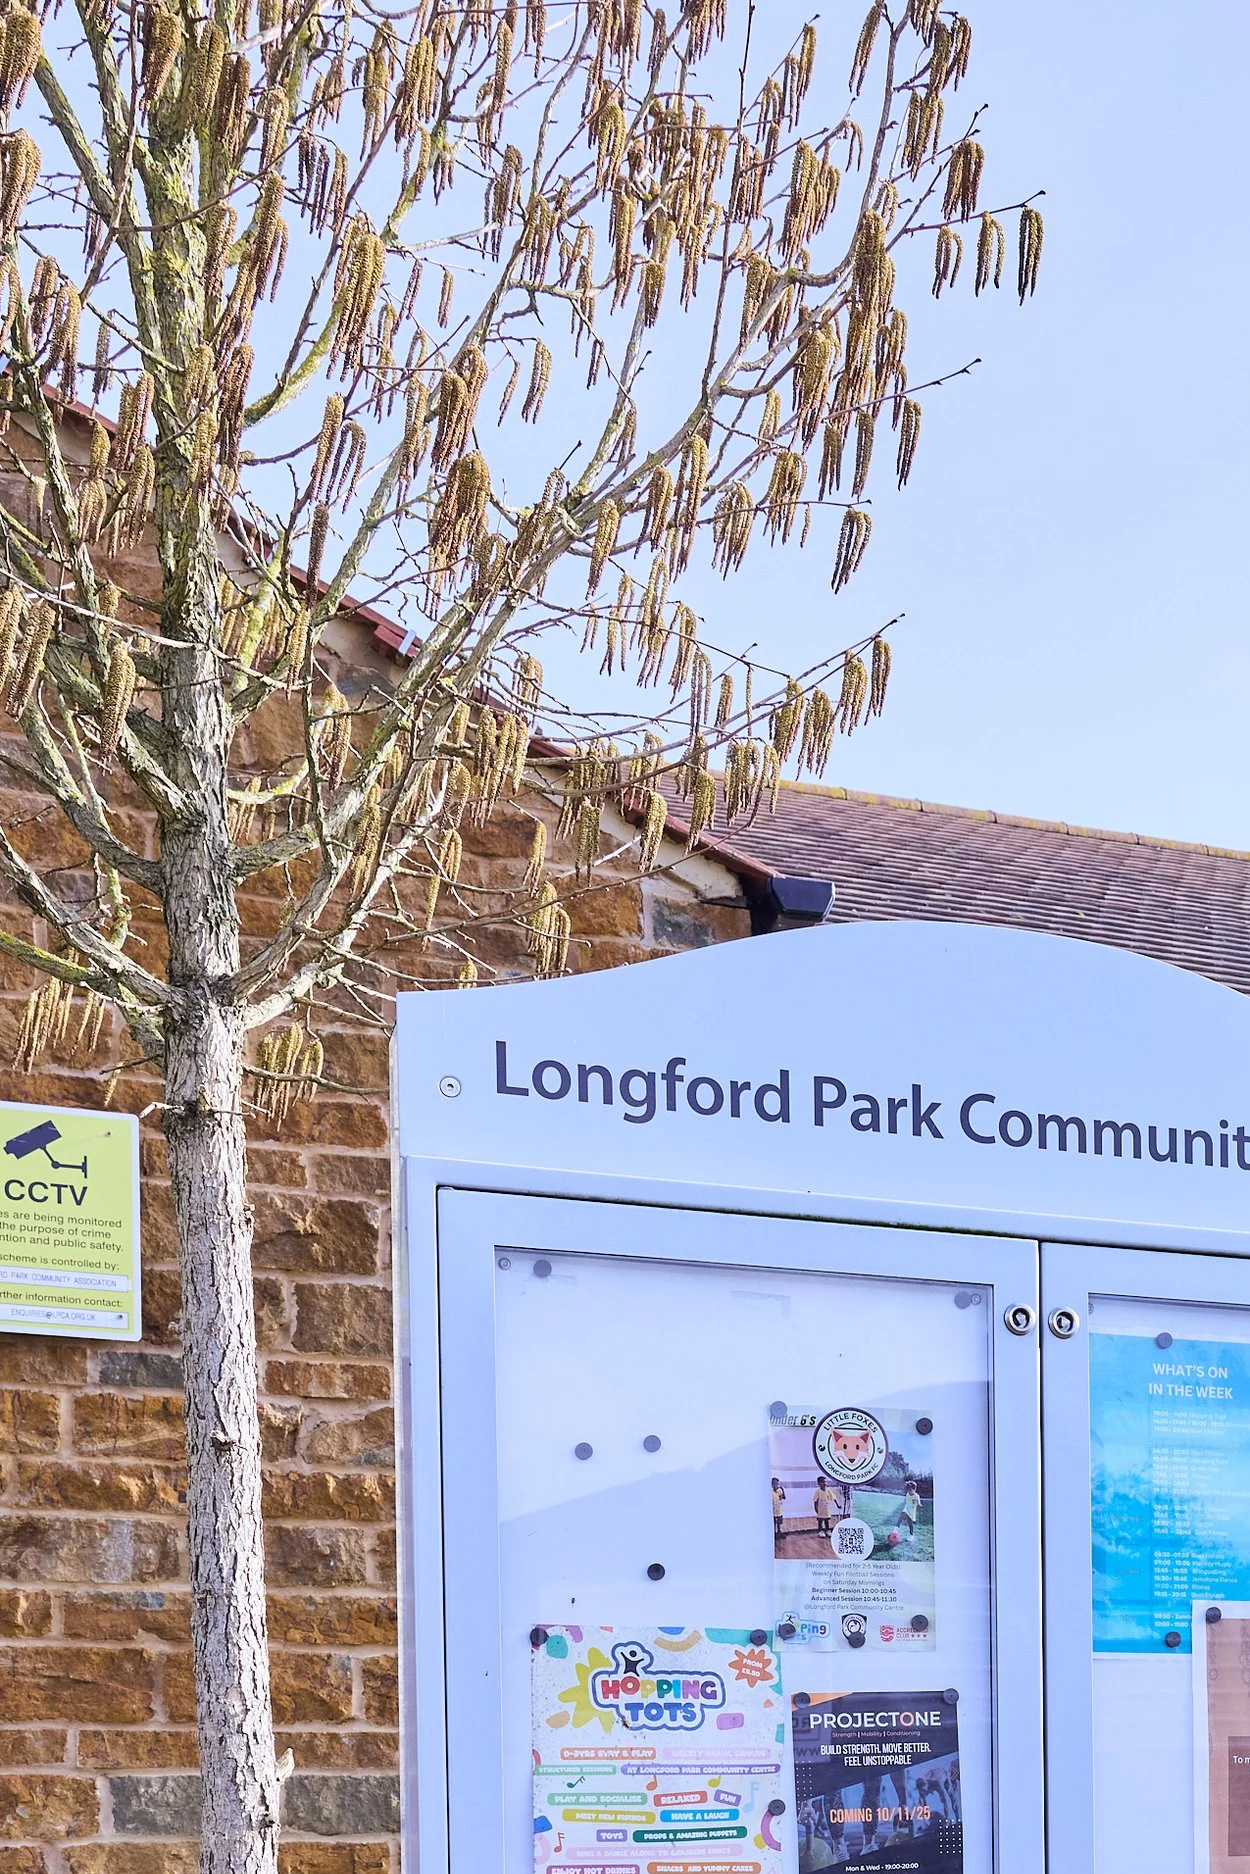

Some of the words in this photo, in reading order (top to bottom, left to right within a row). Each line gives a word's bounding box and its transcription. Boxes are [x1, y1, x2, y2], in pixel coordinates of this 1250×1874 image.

[494, 1040, 790, 1124] Longford
[813, 1076, 943, 1138] Park
[4, 1179, 88, 1206] CCTV
[13, 1212, 30, 1220] are
[33, 1212, 64, 1225] being
[67, 1216, 122, 1228] monitored
[20, 1224, 65, 1235] purpose
[68, 1228, 78, 1236] of
[81, 1229, 111, 1239] crime
[29, 1236, 50, 1245] and
[53, 1238, 87, 1249] public
[89, 1241, 124, 1253] safety.
[40, 1256, 48, 1264] is
[51, 1257, 101, 1269] controlled
[104, 1261, 120, 1272] by:
[11, 1270, 29, 1280] PARK
[32, 1272, 70, 1283] COMMUNITY
[73, 1277, 117, 1288] ASSOCIATION
[25, 1292, 81, 1304] information
[84, 1297, 123, 1308] contact:
[1153, 1362, 1205, 1378] WHAT'S
[1208, 1366, 1228, 1379] ON
[1148, 1383, 1163, 1395] IN
[1166, 1384, 1193, 1397] THE
[1195, 1386, 1233, 1400] WEEK
[823, 1412, 850, 1432] LITTLE
[851, 1412, 878, 1433] FOXES
[824, 1460, 857, 1480] LONGFORD
[856, 1469, 873, 1480] PARK
[849, 1604, 884, 1612] Community
[742, 1658, 763, 1668] FROM
[601, 1676, 717, 1700] HOPPING
[625, 1702, 697, 1722] TOTS
[809, 1711, 942, 1729] PROJECTONE
[860, 1730, 883, 1738] Mobility
[631, 1749, 653, 1757] PLAY
[820, 1743, 842, 1755] BUILD
[843, 1743, 881, 1755] STRENGTH.
[882, 1743, 903, 1754] MOVE
[903, 1742, 931, 1753] BETTER.
[844, 1756, 862, 1767] FEEL
[863, 1754, 912, 1766] UNSTOPPABLE
[1232, 1755, 1243, 1763] To
[554, 1795, 576, 1803] PLAY
[579, 1795, 597, 1803] AND
[660, 1794, 701, 1804] RELAXED
[720, 1793, 737, 1803] FUN
[829, 1807, 873, 1823] COMING
[876, 1805, 931, 1822] 10/11/25
[600, 1832, 624, 1840] TOYS
[643, 1832, 667, 1840] PROPS
[676, 1831, 708, 1839] AMAZING
[551, 1867, 581, 1874] ENJOY
[583, 1867, 603, 1874] HOT
